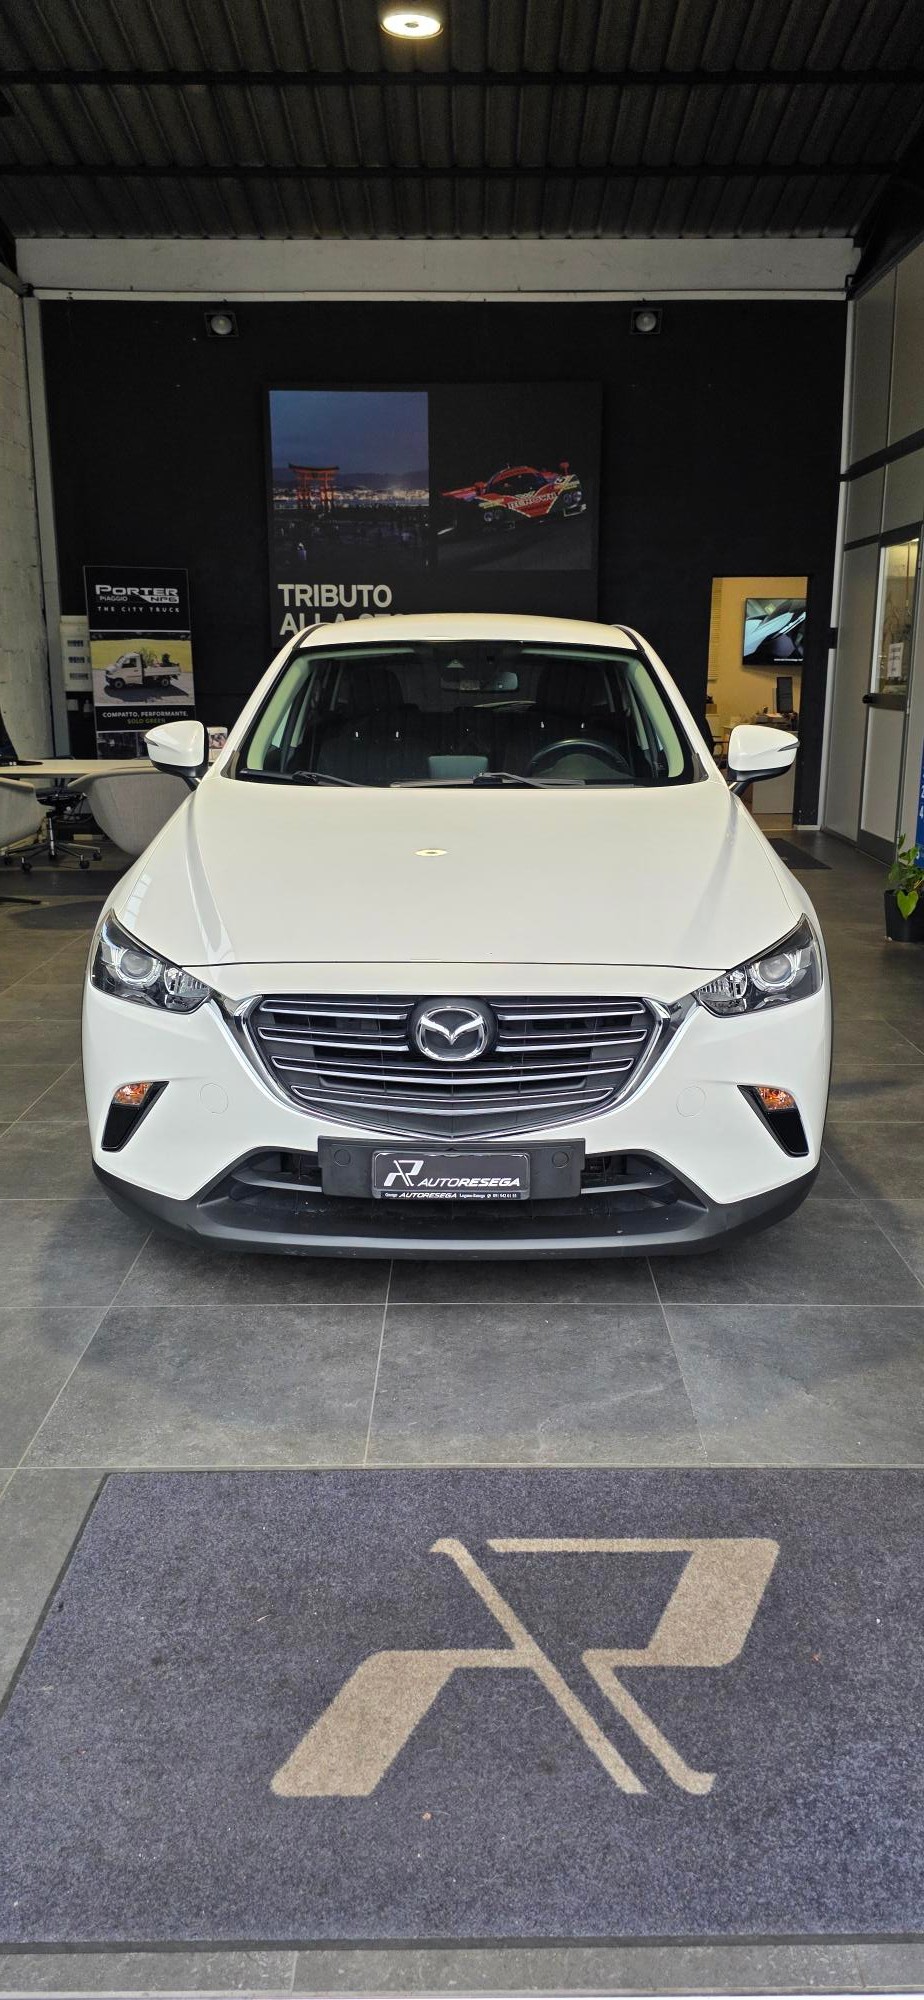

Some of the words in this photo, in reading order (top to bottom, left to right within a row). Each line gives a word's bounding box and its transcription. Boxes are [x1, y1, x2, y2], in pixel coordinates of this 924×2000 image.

[95, 584, 178, 597] PORTER
[277, 583, 393, 608] TRIBUTO
[417, 1177, 521, 1187] AUTORESEGA
